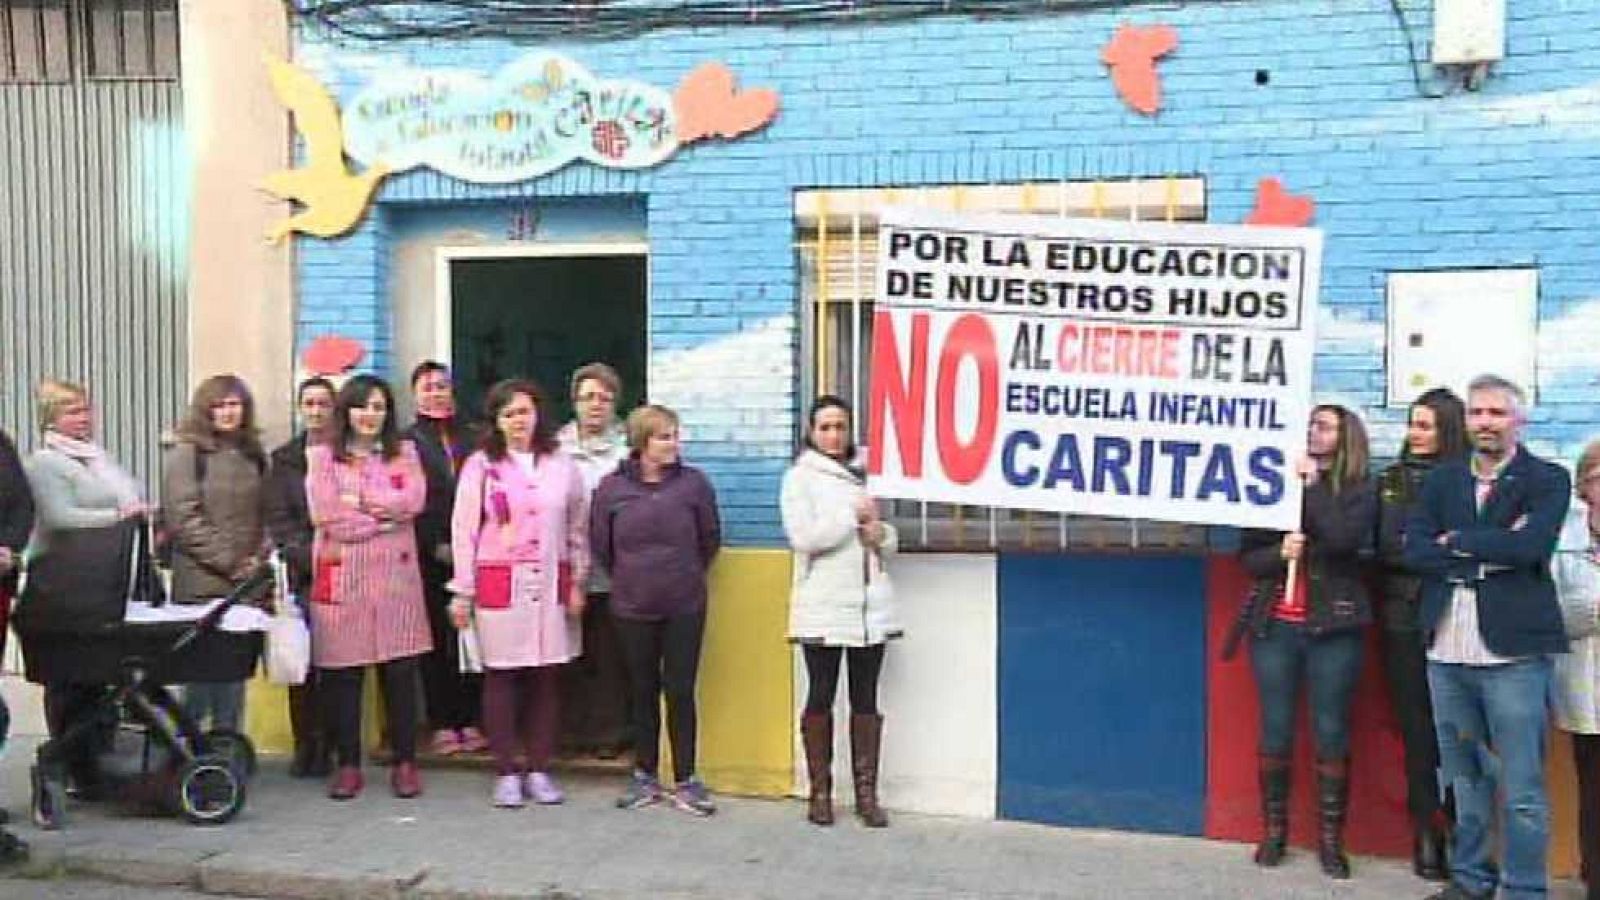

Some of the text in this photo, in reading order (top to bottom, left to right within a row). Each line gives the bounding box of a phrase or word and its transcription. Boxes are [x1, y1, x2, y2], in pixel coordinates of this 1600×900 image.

[890, 233, 1290, 280] POR LA EDUCACION
[887, 269, 1288, 319] DE NUESTROS HIJOS
[1009, 321, 1287, 386] AL CIERRE DE LA
[868, 311, 999, 486] NO
[1006, 382, 1287, 430] ESCUELA INFANTIL
[1001, 429, 1287, 506] CARITAS
